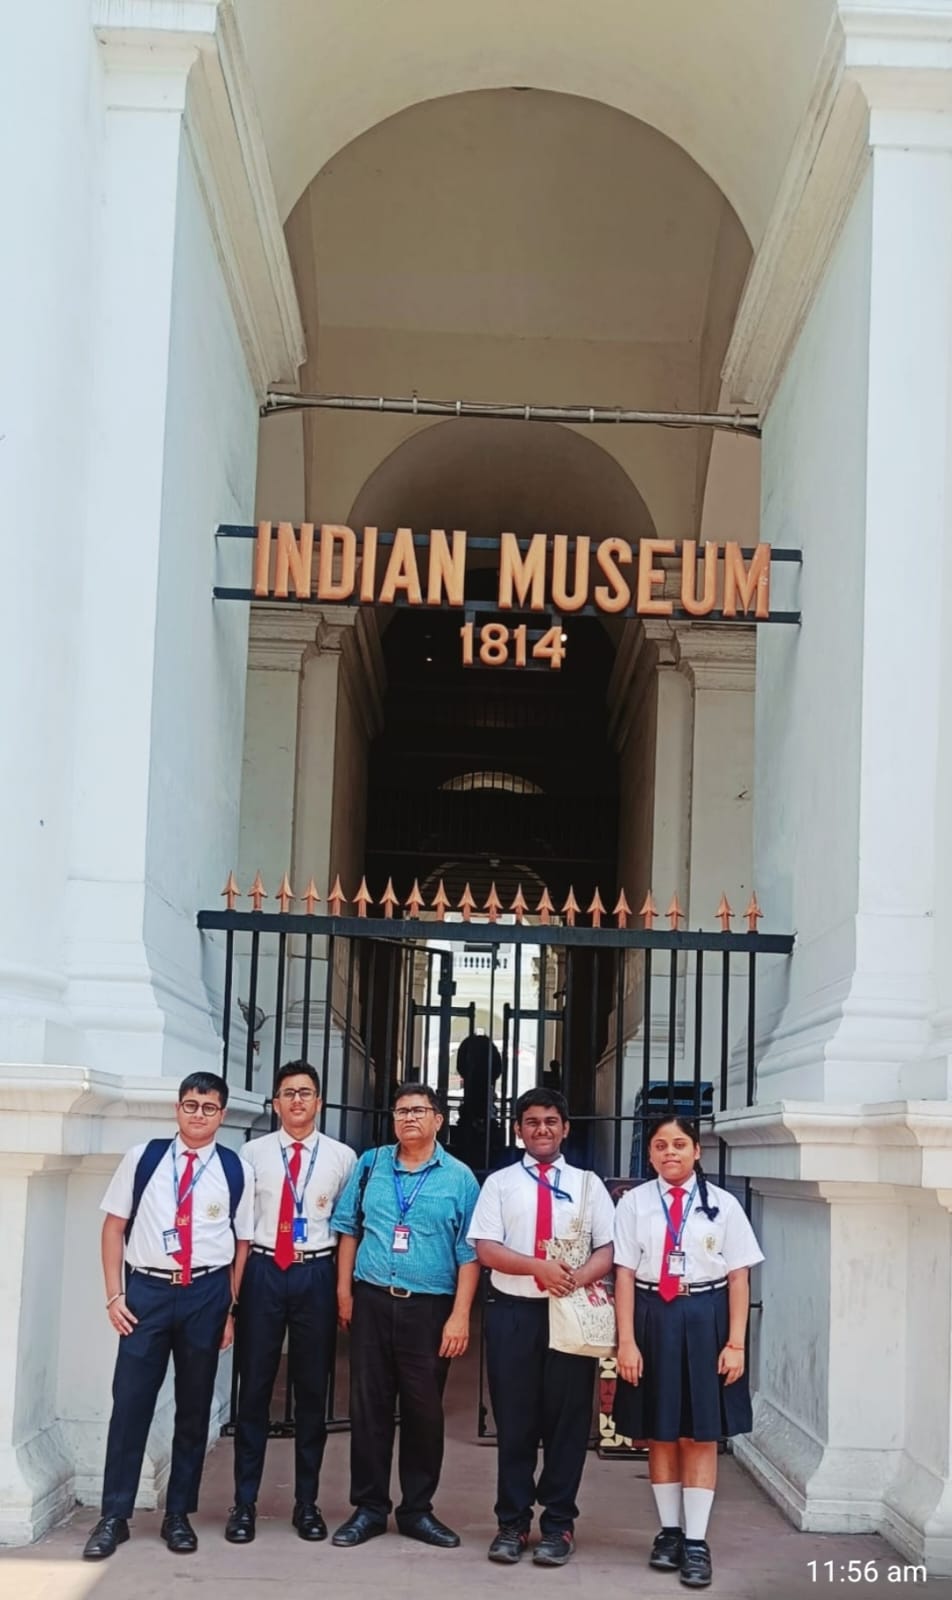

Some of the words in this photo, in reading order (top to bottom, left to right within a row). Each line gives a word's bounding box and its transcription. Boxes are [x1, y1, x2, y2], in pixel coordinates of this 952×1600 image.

[254, 521, 467, 605] INDIAN
[498, 532, 771, 618] MUSEUM
[460, 622, 566, 668] 1814
